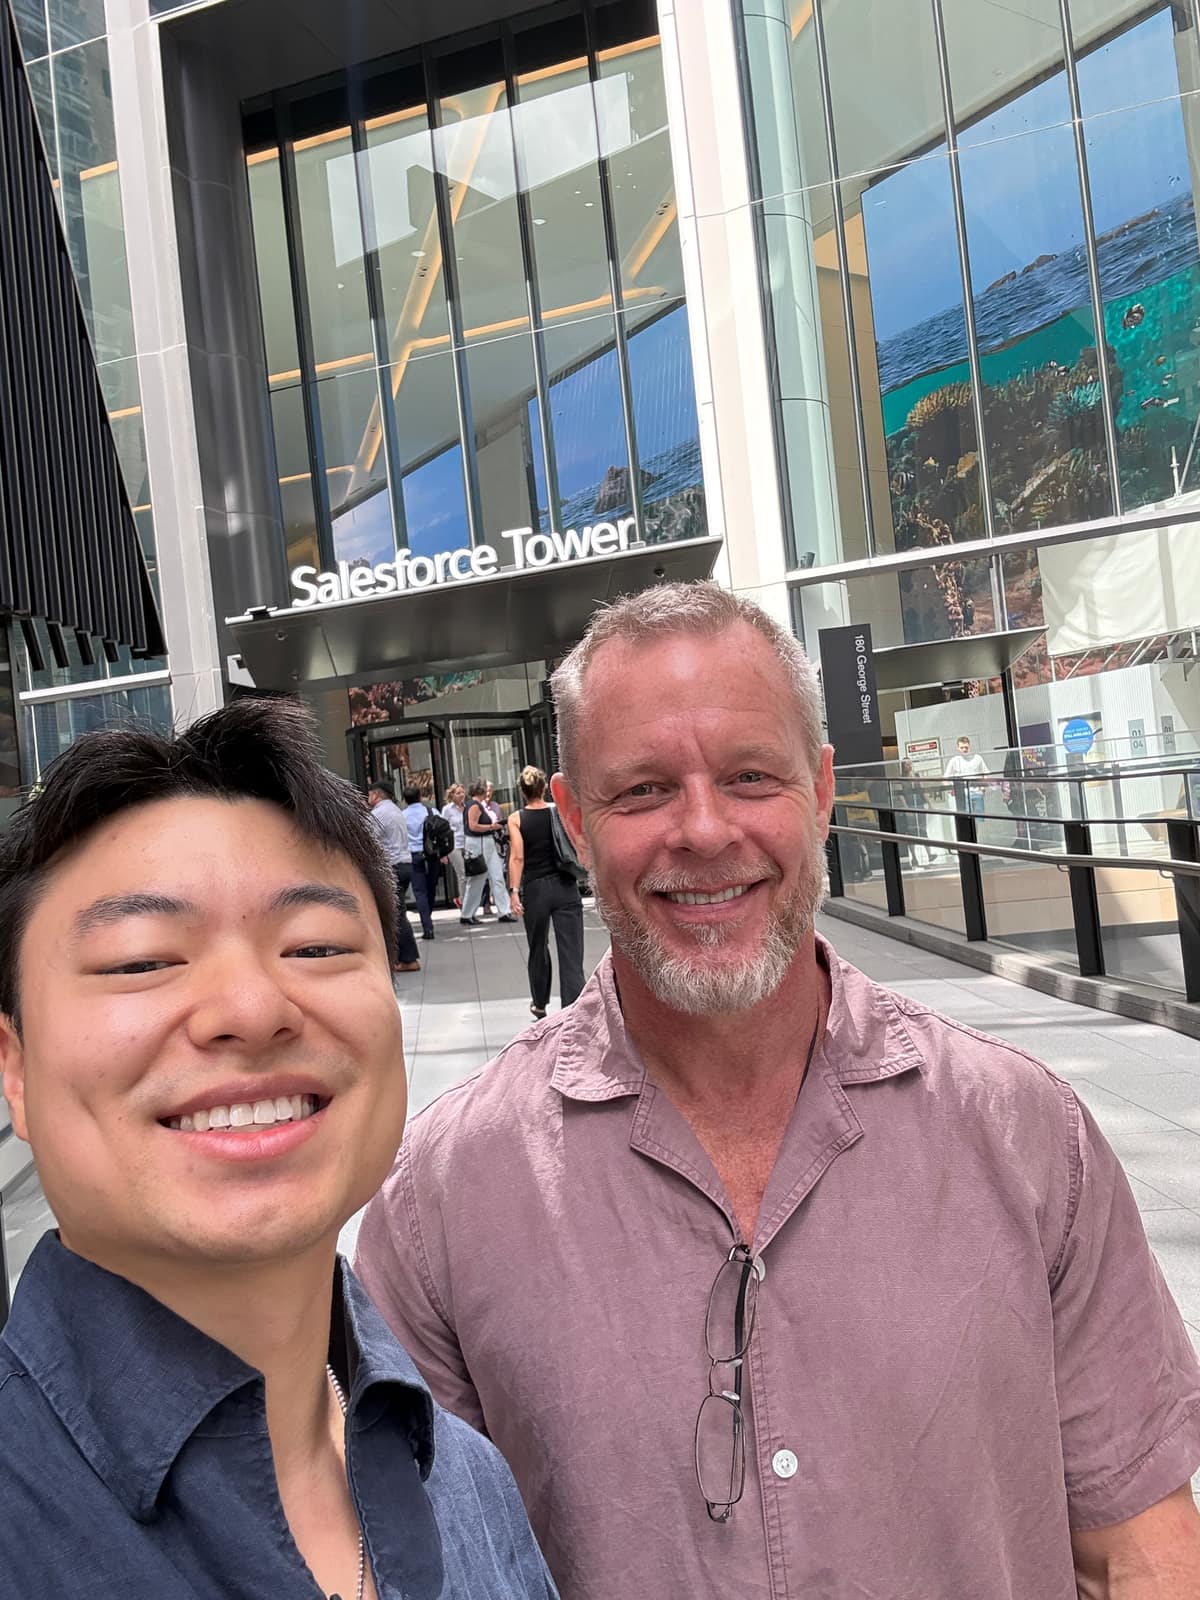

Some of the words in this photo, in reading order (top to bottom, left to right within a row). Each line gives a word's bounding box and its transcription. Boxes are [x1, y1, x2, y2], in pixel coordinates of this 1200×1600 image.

[291, 546, 498, 607] Salesforce
[502, 518, 636, 569] Tower
[854, 634, 865, 653] 180
[856, 655, 867, 692] George
[860, 694, 872, 724] Street
